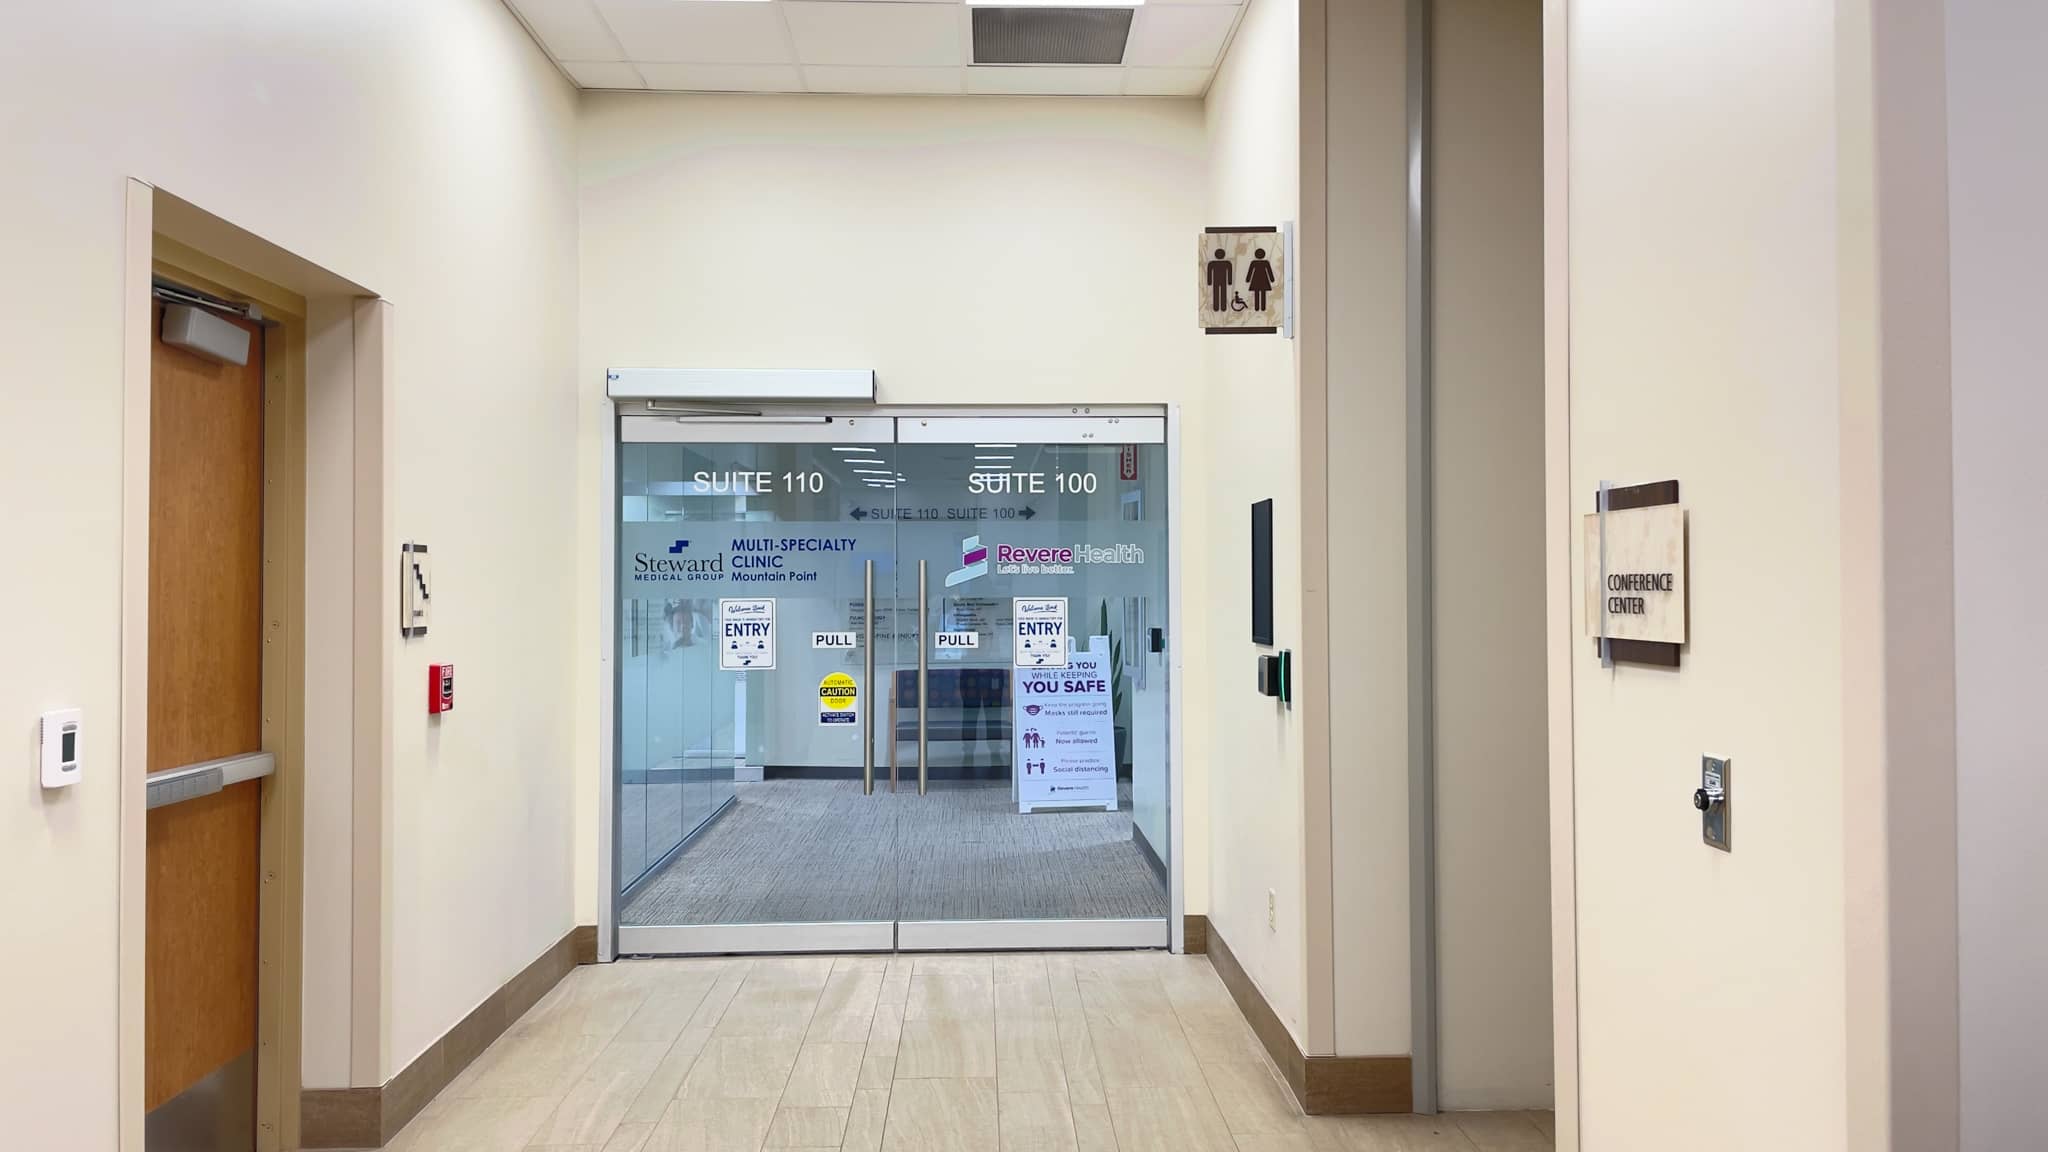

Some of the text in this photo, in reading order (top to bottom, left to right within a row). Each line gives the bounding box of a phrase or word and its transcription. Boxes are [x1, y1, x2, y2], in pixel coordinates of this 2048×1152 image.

[693, 471, 824, 493] SUITE 110
[968, 472, 1098, 494] SUITE 100
[871, 508, 938, 520] SUITE 110
[947, 507, 1015, 519] SUITE 100
[731, 538, 856, 551] MULTI-SPECIALTY
[634, 552, 723, 573] Steward
[731, 555, 783, 568] CLINIC
[1021, 564, 1040, 574] live
[731, 571, 817, 582] Mountain Point
[1608, 573, 1673, 591] CONFERENCE
[1608, 597, 1645, 614] CENTER
[725, 622, 771, 637] ENTRY
[1018, 622, 1063, 636] ENTRY
[816, 634, 852, 646] PULL
[938, 634, 975, 646] PULL
[1061, 671, 1098, 679] KEEPING
[821, 687, 856, 696] CAUTION
[1022, 680, 1106, 694] YOU SAFE
